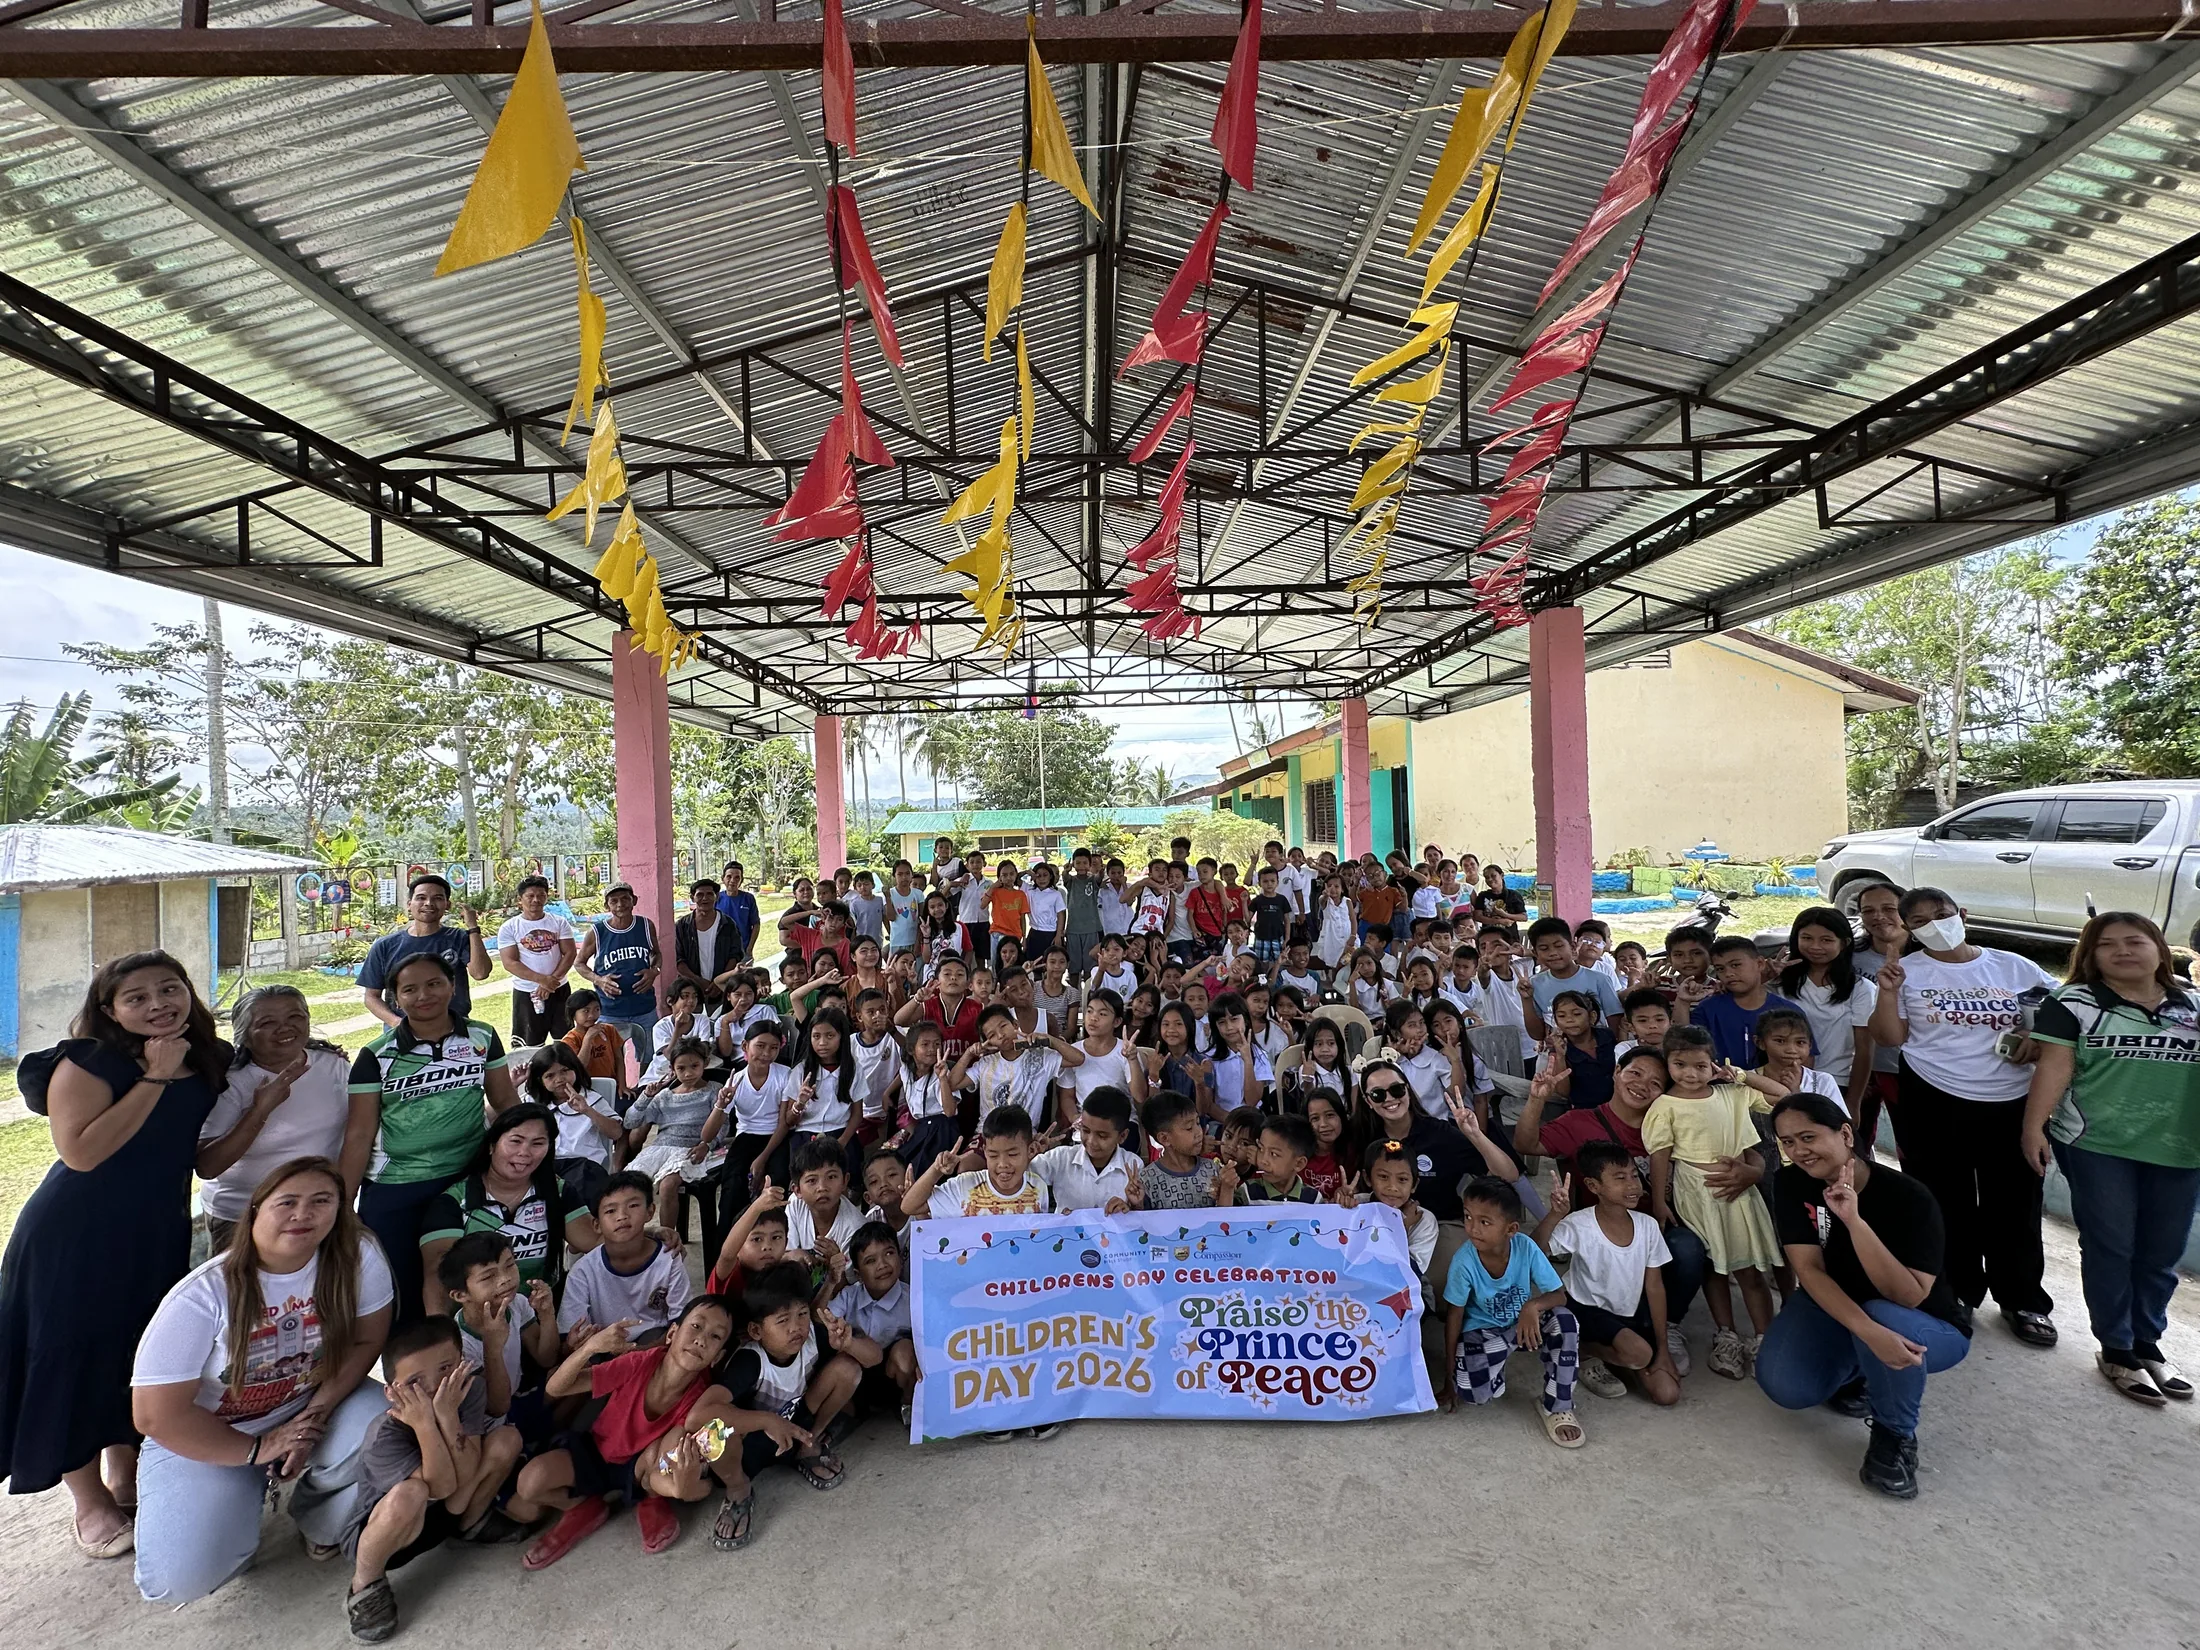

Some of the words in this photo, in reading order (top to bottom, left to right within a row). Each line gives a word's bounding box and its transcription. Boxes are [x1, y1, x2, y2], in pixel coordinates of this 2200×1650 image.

[603, 946, 649, 971] ACHIEVE
[1920, 987, 1988, 1000] Praise
[1933, 998, 2018, 1012] Prince
[1926, 1011, 1941, 1024] of
[1945, 1011, 2023, 1031] Peace
[2086, 1034, 2200, 1050] SIBON
[2113, 1049, 2200, 1063] DISTRIC
[402, 1078, 479, 1101] DISTRICT
[514, 1246, 547, 1259] RICT
[1103, 1250, 1147, 1259] COMMUNITY
[985, 1273, 1115, 1297] CHILDRENS
[1123, 1269, 1165, 1287] DAY
[1174, 1268, 1337, 1285] CELEBRATION
[1179, 1297, 1308, 1328] Praise
[1314, 1299, 1367, 1331] the
[1198, 1328, 1357, 1361] Prince
[954, 1363, 1036, 1409] DAY
[1056, 1351, 1151, 1393] 2026
[1176, 1361, 1213, 1389] of
[1217, 1356, 1377, 1406] Peace
